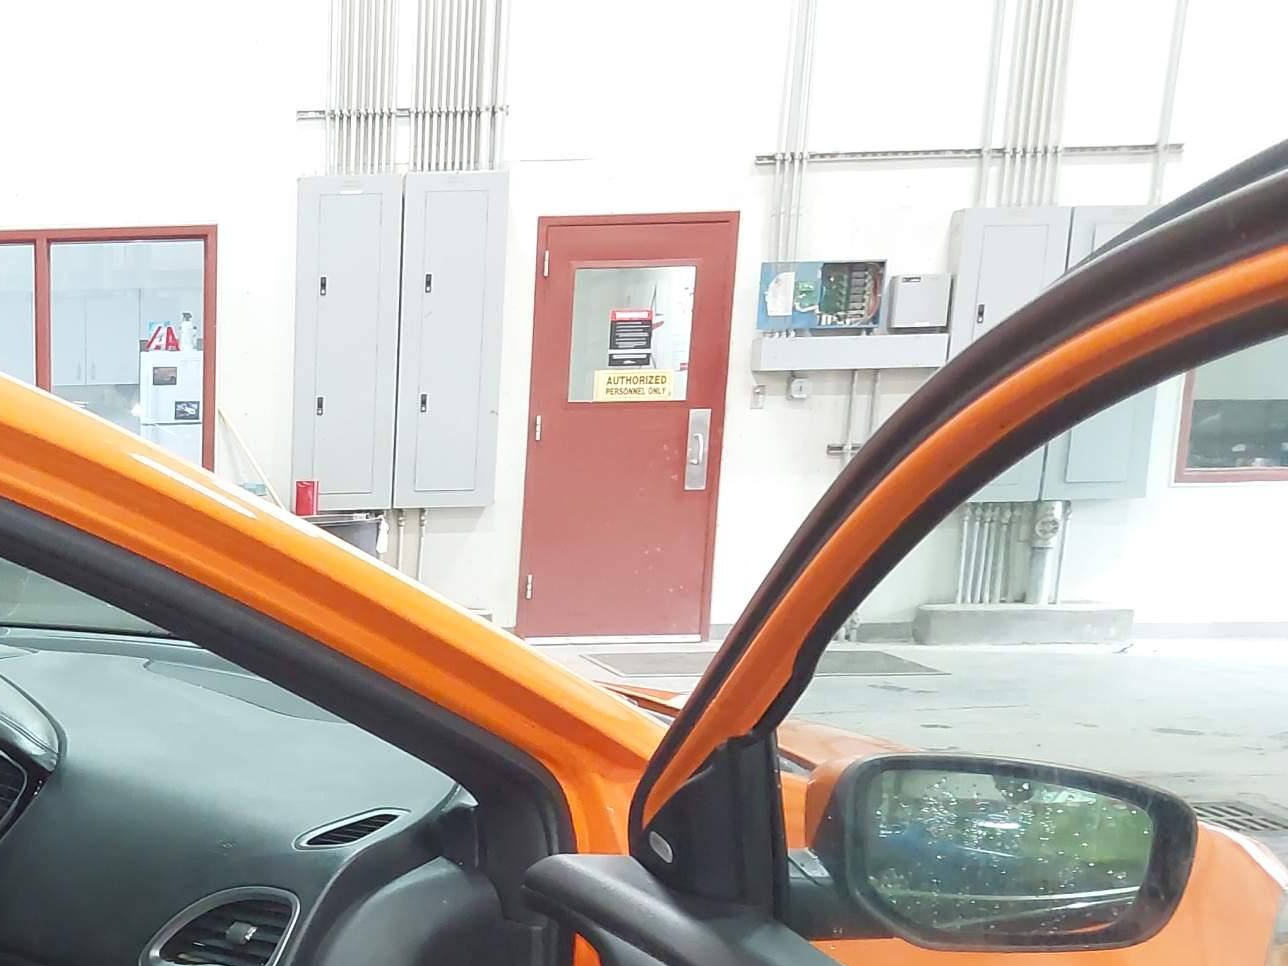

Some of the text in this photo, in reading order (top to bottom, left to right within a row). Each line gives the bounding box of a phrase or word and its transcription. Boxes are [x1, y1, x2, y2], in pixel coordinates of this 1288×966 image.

[606, 375, 667, 385] AUTHORIZED
[605, 387, 666, 395] PERSONNEL ONLY
